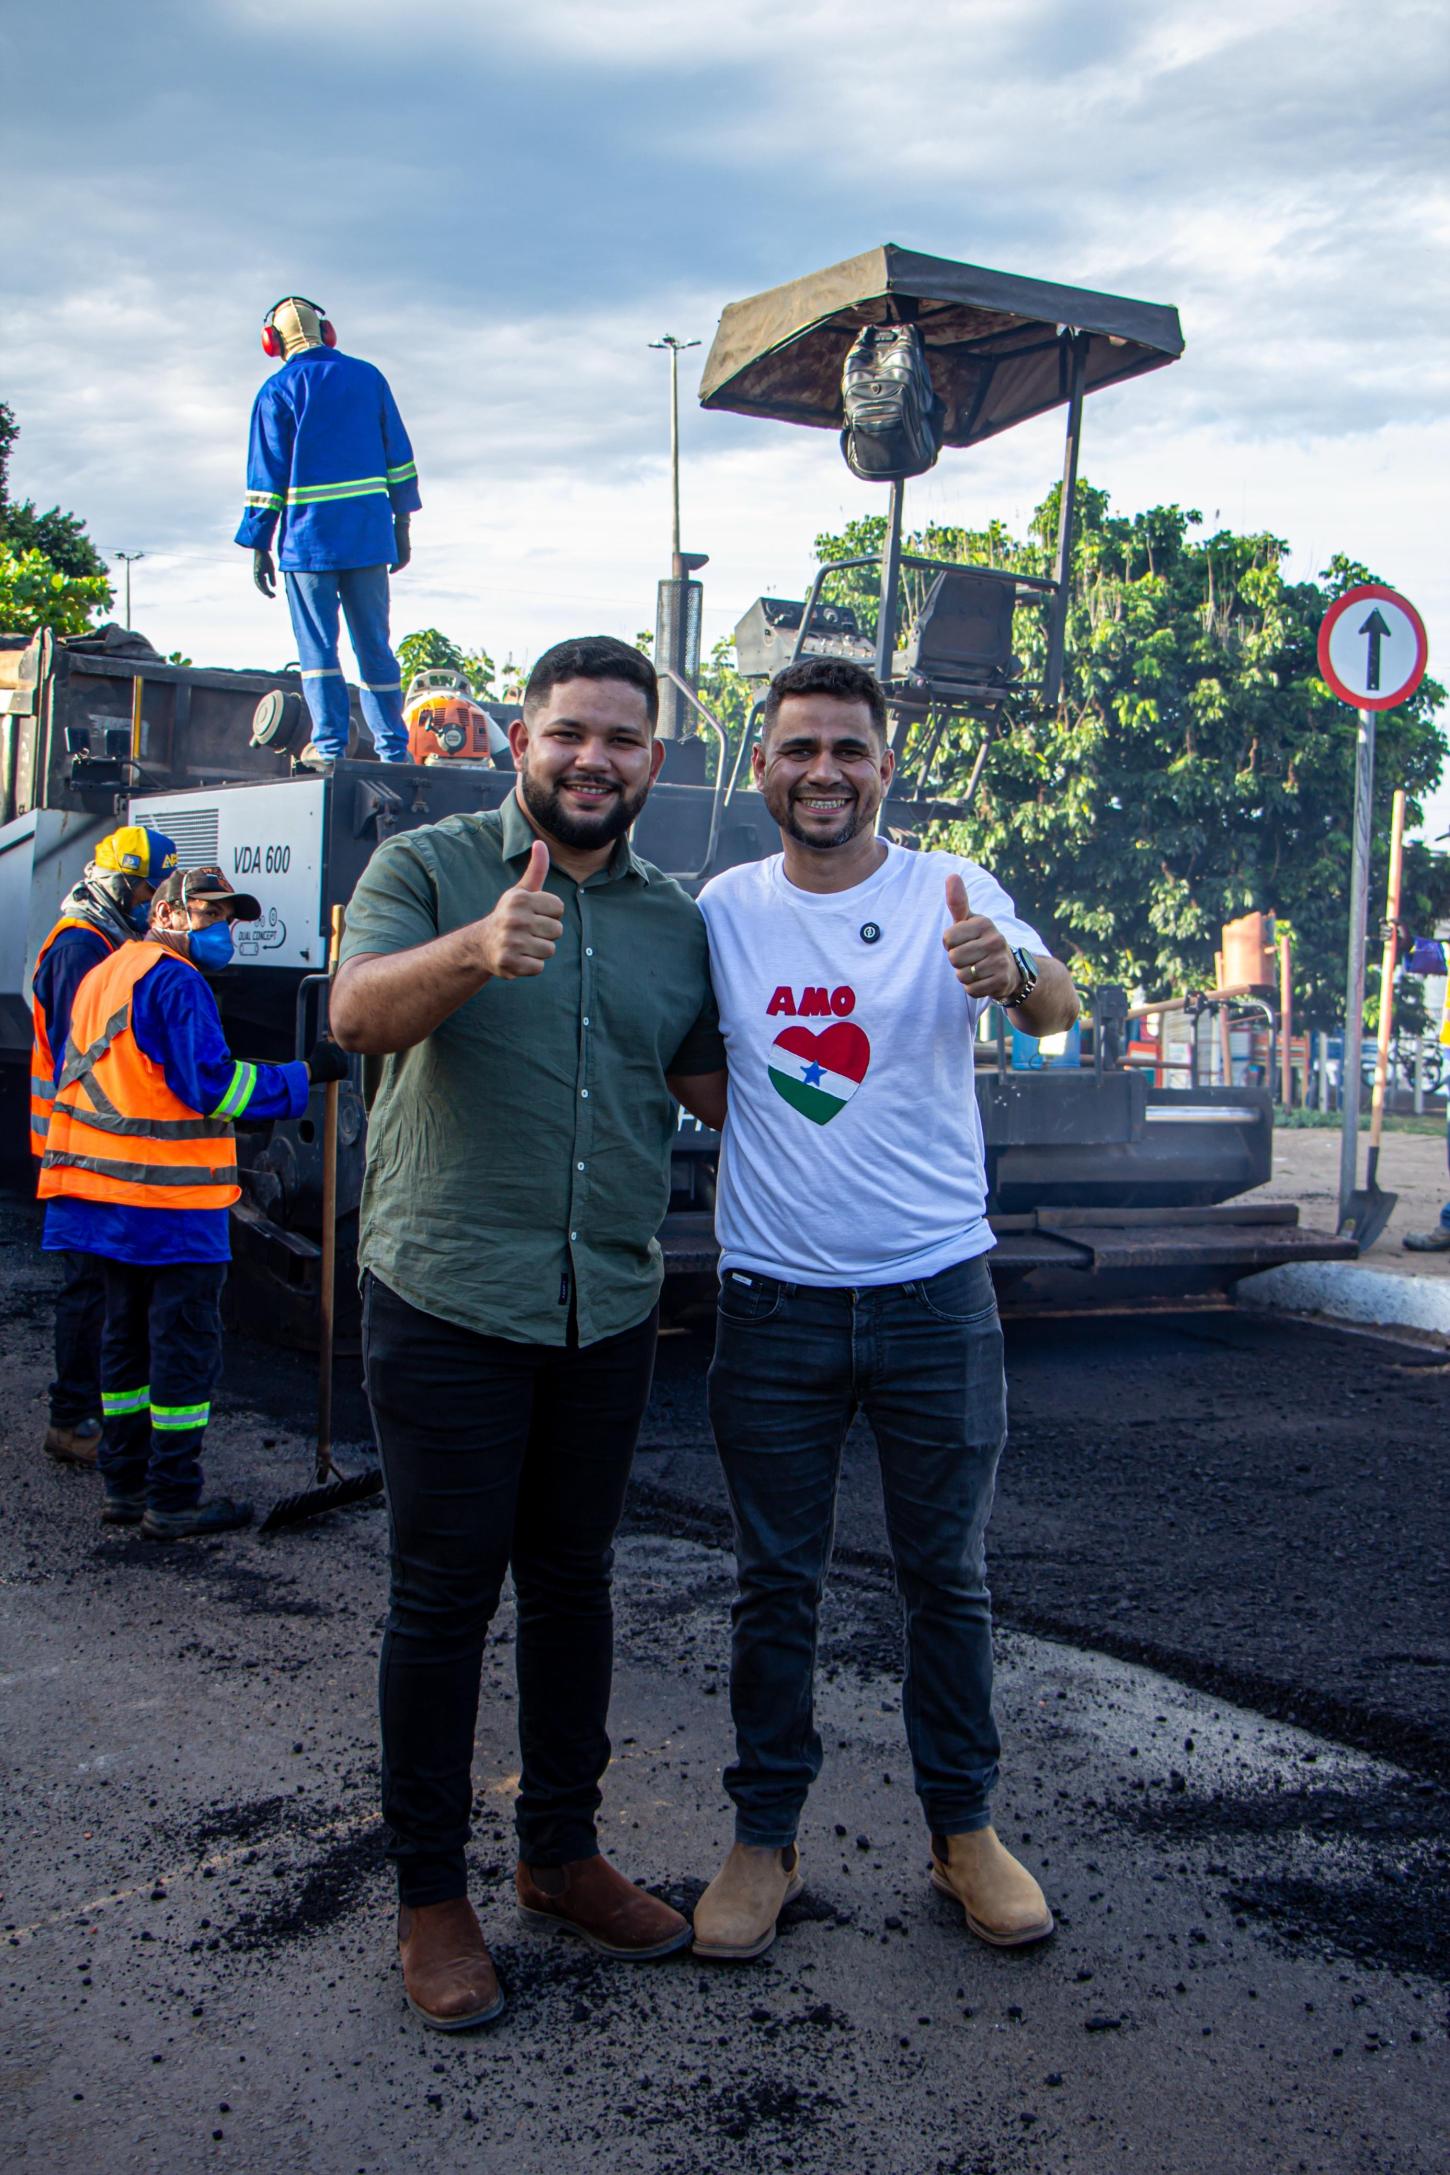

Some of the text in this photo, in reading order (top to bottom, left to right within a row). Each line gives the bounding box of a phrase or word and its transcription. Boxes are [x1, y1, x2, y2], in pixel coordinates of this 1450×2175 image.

[234, 845, 291, 874] VDA 600
[238, 930, 277, 941] DUAL CONCEPT
[766, 986, 856, 1017] AMO
